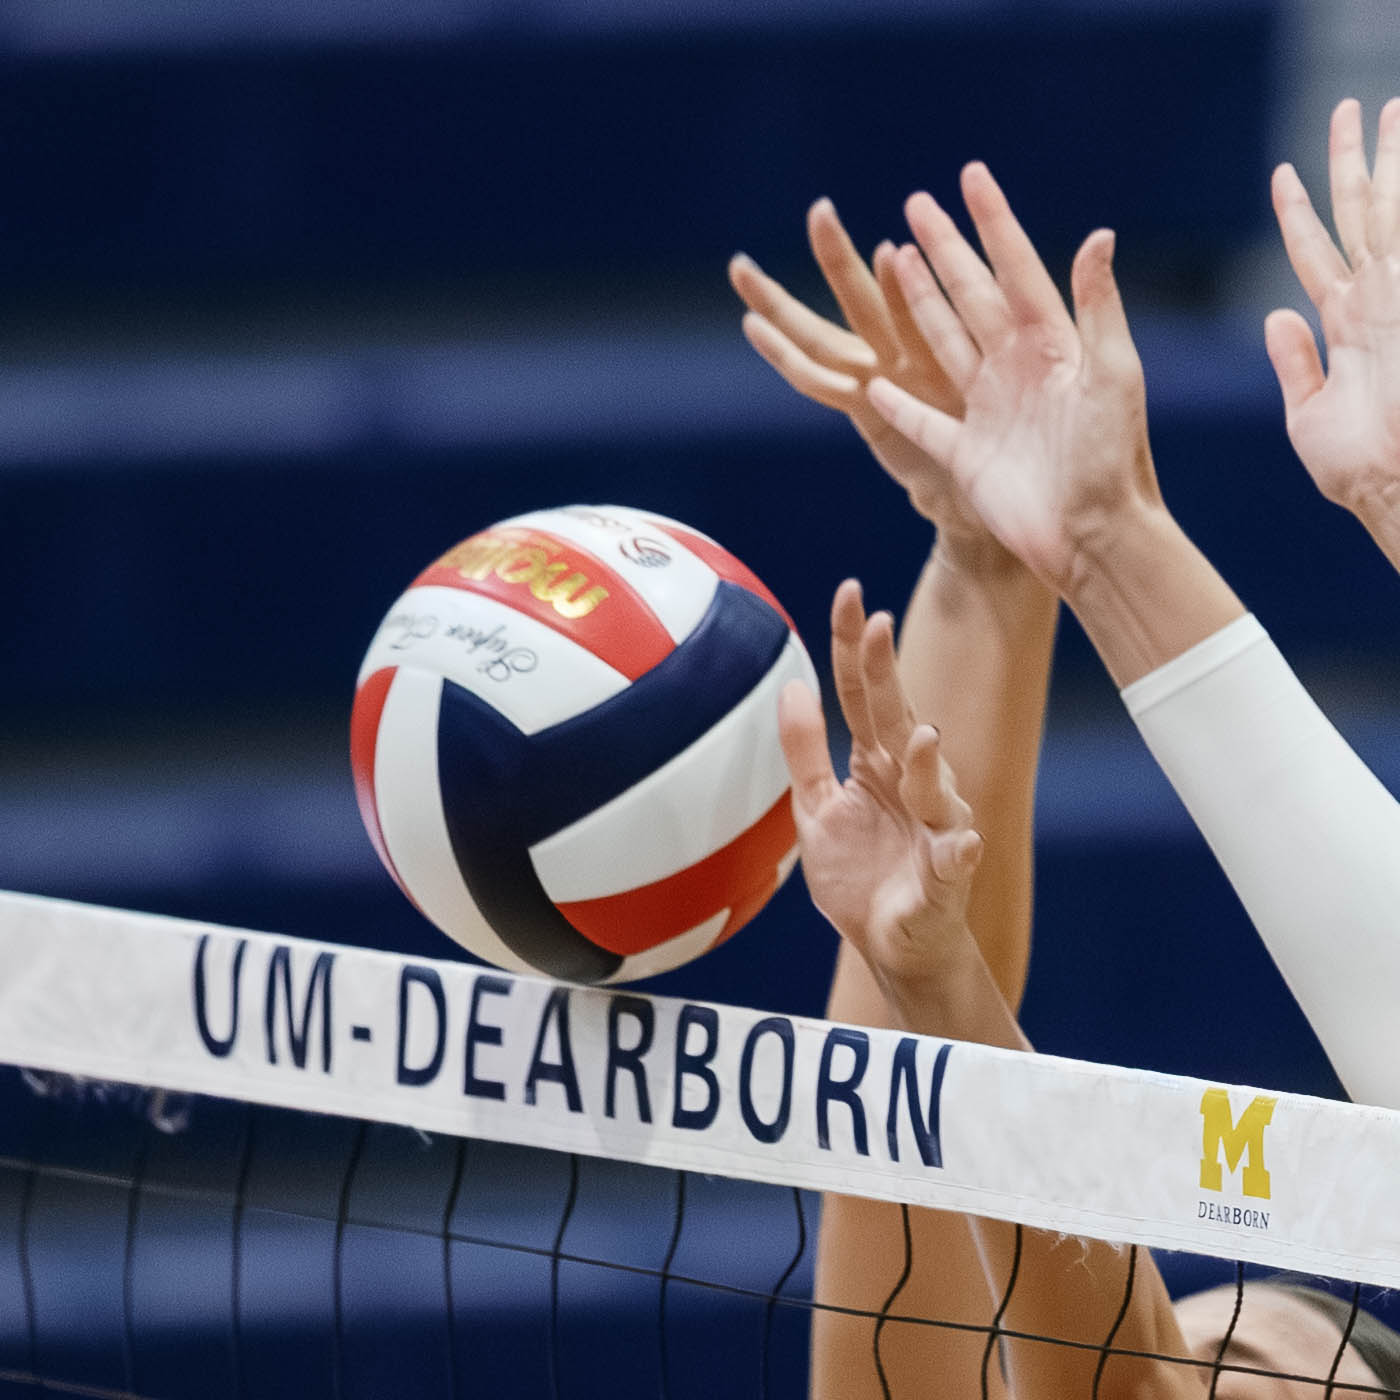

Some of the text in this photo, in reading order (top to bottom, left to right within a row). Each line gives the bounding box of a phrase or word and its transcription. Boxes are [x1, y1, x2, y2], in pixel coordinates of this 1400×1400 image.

[192, 934, 953, 1169] UM-DEARBORN
[1199, 1087, 1277, 1200] M
[1198, 1201, 1271, 1230] DEARBORN
